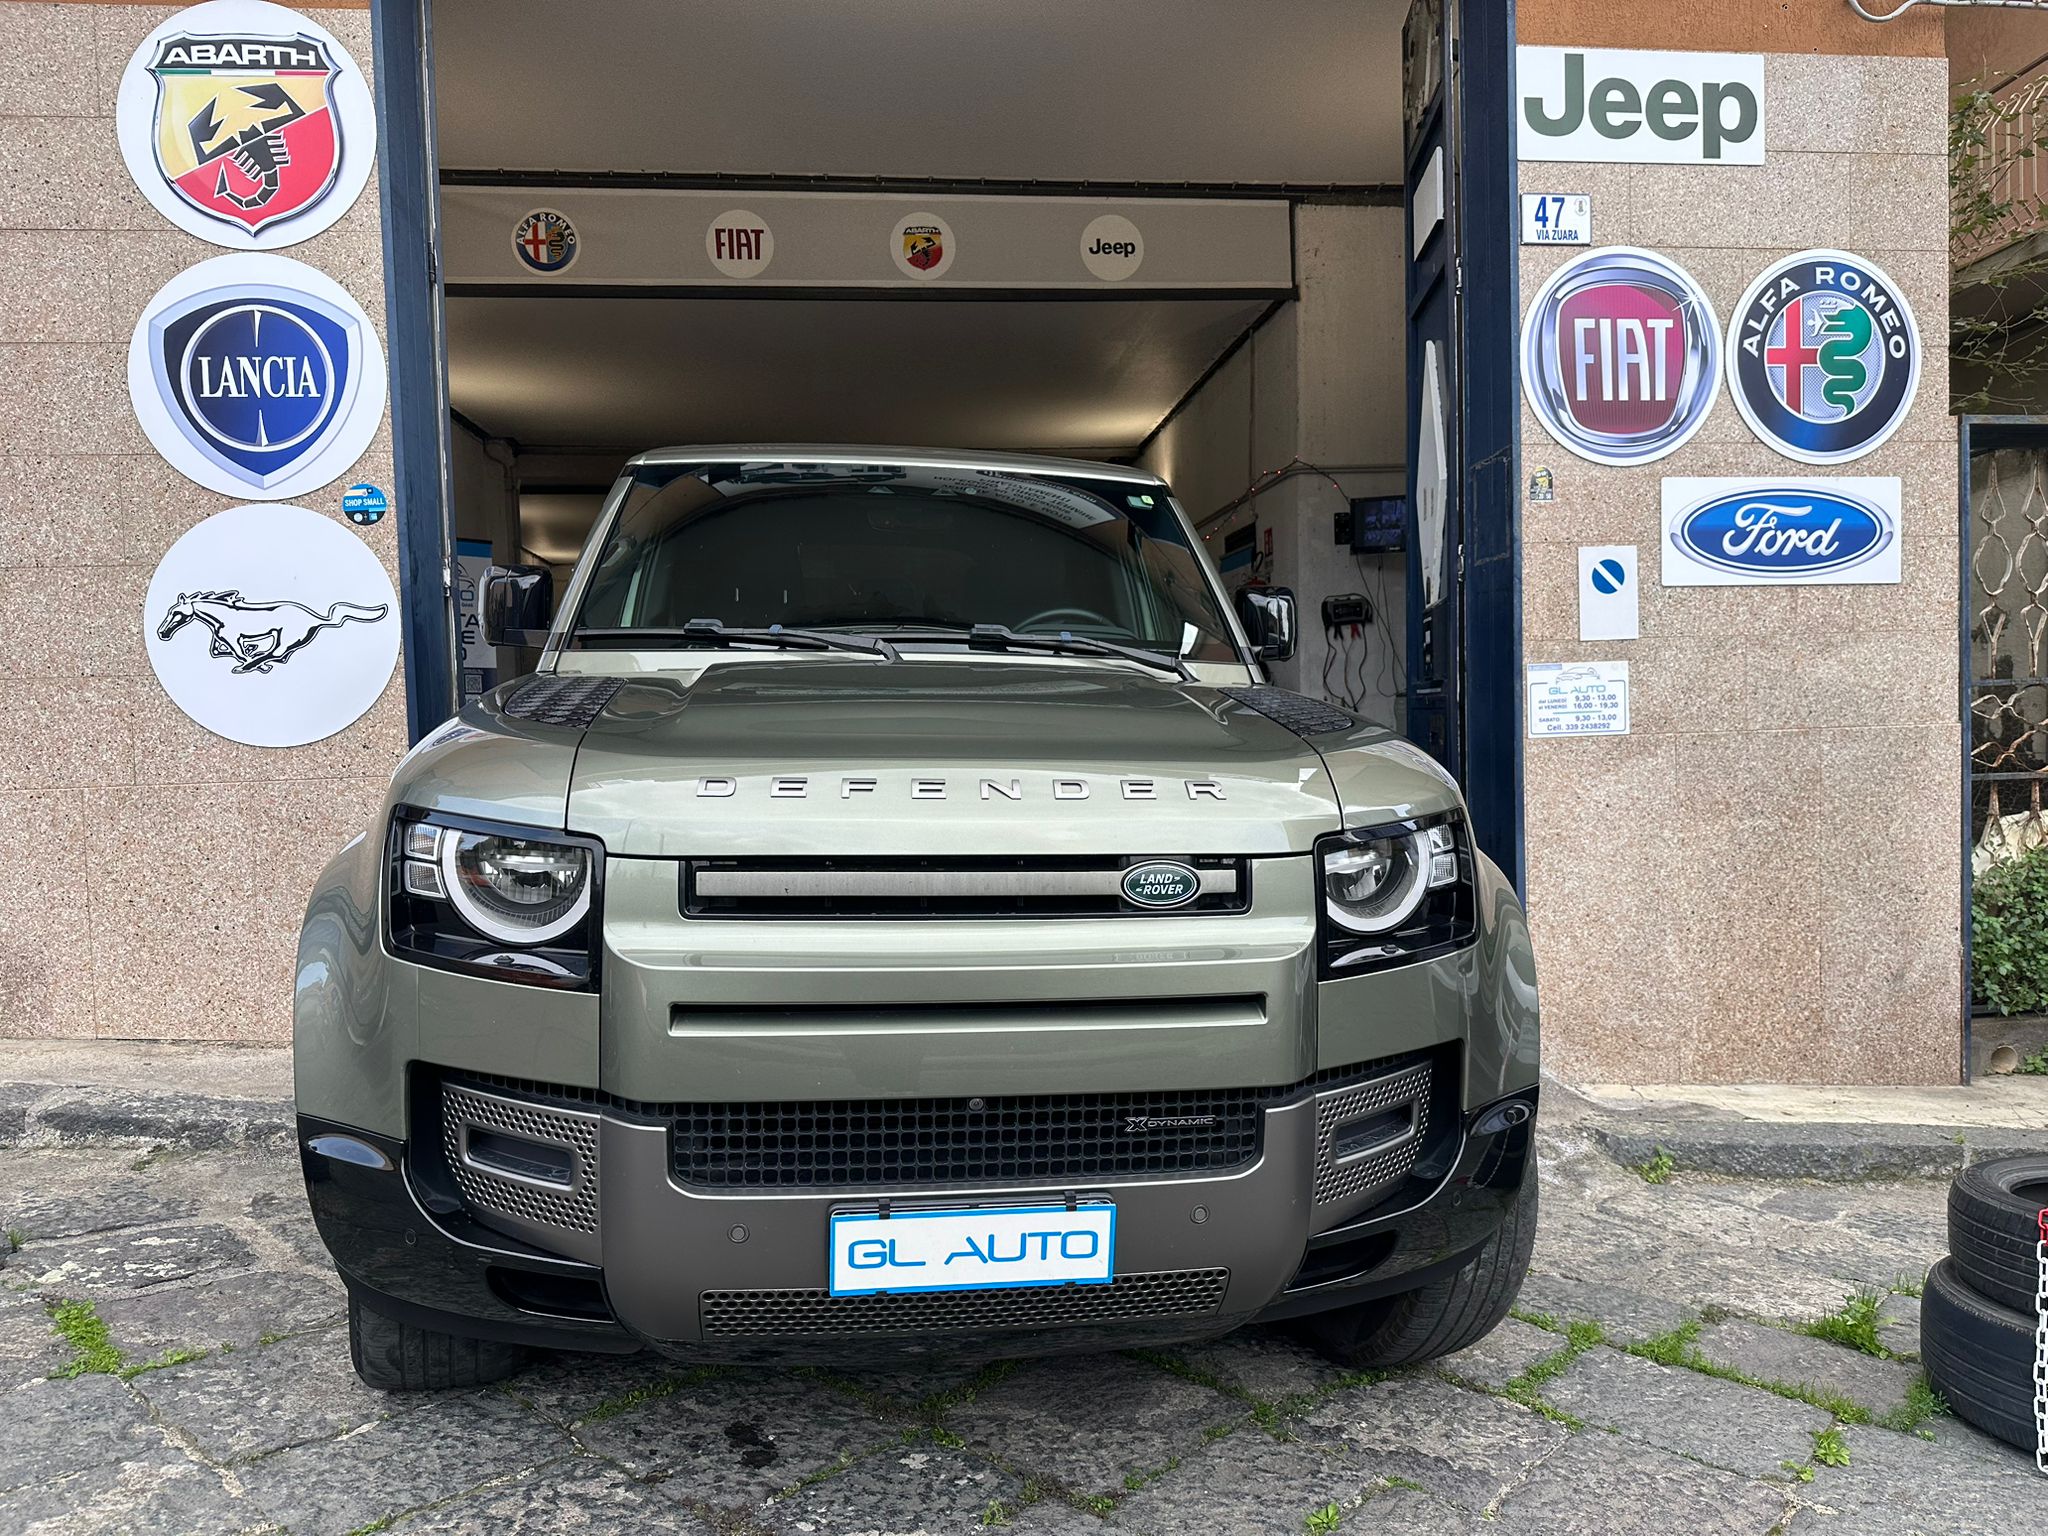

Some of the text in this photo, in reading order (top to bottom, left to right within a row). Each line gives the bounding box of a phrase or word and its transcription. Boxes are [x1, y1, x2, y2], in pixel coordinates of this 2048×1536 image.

[163, 43, 316, 66] ABARTH
[1523, 53, 1758, 159] Jeep
[1534, 196, 1565, 228] 47
[516, 213, 576, 245] ALFA ROMEO
[714, 228, 764, 260] FIAT
[905, 226, 940, 234] ABARTH
[1536, 230, 1579, 240] VIA ZUARA
[1088, 238, 1136, 258] Jeep
[1742, 266, 1906, 359] ALFA ROMEO
[1573, 318, 1675, 401] FIAT
[198, 355, 322, 399] LANCIA
[344, 497, 385, 507] SHOP SMALL
[1722, 503, 1842, 557] Ford
[1548, 684, 1606, 695] GL AUTO
[696, 776, 1228, 801] DEFENDER
[848, 1230, 1099, 1269] GL AUTO
